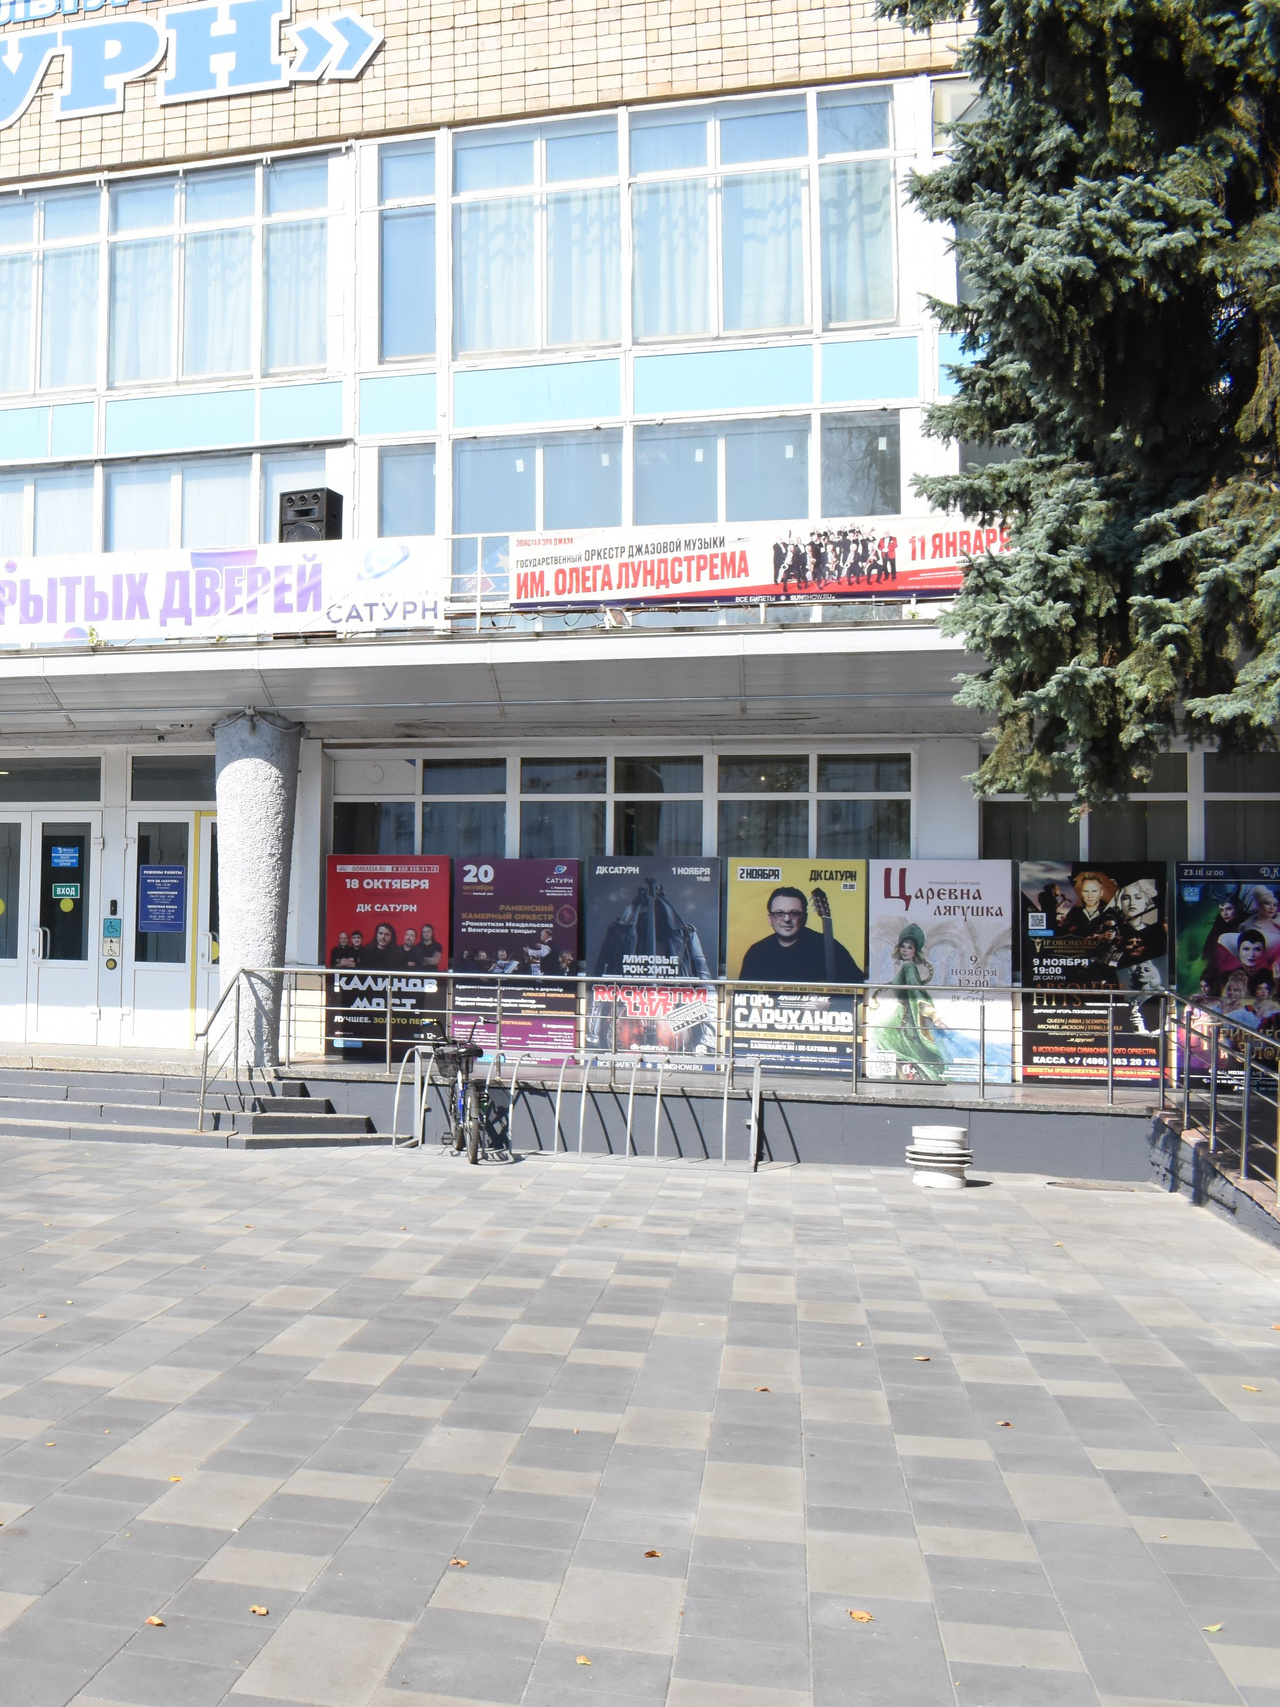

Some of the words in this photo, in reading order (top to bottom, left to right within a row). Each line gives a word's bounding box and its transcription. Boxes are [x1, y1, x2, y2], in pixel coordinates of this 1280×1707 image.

[516, 539, 541, 547] ЗОЛОТАЯ
[554, 537, 573, 546] ДЖАЗА
[909, 534, 926, 561] 11
[931, 527, 1012, 560] ЯНВАРЯ
[516, 552, 582, 569] ГОСУДАРСТВЕННЫЙ
[584, 546, 626, 562] ОРКЕСТР
[628, 537, 682, 559] ДЖАЗОВОЙ
[684, 535, 726, 551] МУЗЫКИ
[515, 571, 550, 600] ИМ.
[554, 562, 613, 596] ОЛЕГА
[616, 550, 750, 590] ЛУНДСТРЕМА
[159, 553, 323, 627] ДВЕРЕЙ
[326, 600, 438, 624] САТУРН
[462, 864, 495, 883] 20
[595, 865, 608, 875] ДК
[608, 866, 640, 875] САТУРН
[671, 867, 676, 875] 1
[677, 867, 711, 875] НОЯБРЯ
[739, 868, 745, 879] 2
[746, 868, 780, 880] НОЯБРЯ
[809, 869, 824, 882] ДК
[824, 870, 857, 881] САТУРН
[345, 878, 360, 889] 18
[363, 879, 430, 890] ОКТЯБРЯ
[883, 867, 983, 912] Царевна
[56, 887, 76, 896] ВХОД
[356, 904, 372, 913] ДК
[374, 904, 417, 912] САТУРН
[499, 903, 554, 912] РАМЕНСКИЙ
[933, 905, 1004, 921] лягушка
[461, 912, 512, 920] КАМЕРНЫЙ
[514, 913, 554, 921] ОРКЕСТР
[467, 926, 509, 934] Венгерские
[505, 921, 554, 929] Мендельсона
[622, 954, 679, 964] МИРОВЫЕ
[970, 954, 978, 965] 9
[1033, 958, 1040, 966] 9
[1042, 958, 1089, 967] НОЯБРЯ
[622, 964, 679, 974] РОК-ХИТЫ
[950, 966, 998, 979] ноября
[1033, 966, 1062, 975] 19:00
[334, 973, 438, 993] КАЛИНОВ
[592, 983, 709, 1004] ROCKESTRA
[951, 995, 961, 1003] ДК
[734, 993, 774, 1007] ИГОРЬ
[625, 1000, 674, 1018] LIVE
[333, 1015, 372, 1024] ЛУЧШЕЕ.
[734, 1008, 854, 1033] САРУХАНОВ
[425, 1032, 437, 1040] 12+
[630, 1043, 669, 1051] dk-saturn.ru
[1038, 1045, 1077, 1053] ИСПОЛНЕНИИ
[1127, 1047, 1157, 1055] ОРКЕСТРА
[597, 1060, 611, 1068] ВСЕ
[1032, 1056, 1066, 1065] КАССА
[1068, 1057, 1080, 1065] +7
[1082, 1056, 1108, 1066] (496)
[1112, 1058, 1128, 1066] 63
[1129, 1058, 1142, 1066] 20
[1144, 1059, 1157, 1067] 76
[901, 1064, 918, 1075] 0+
